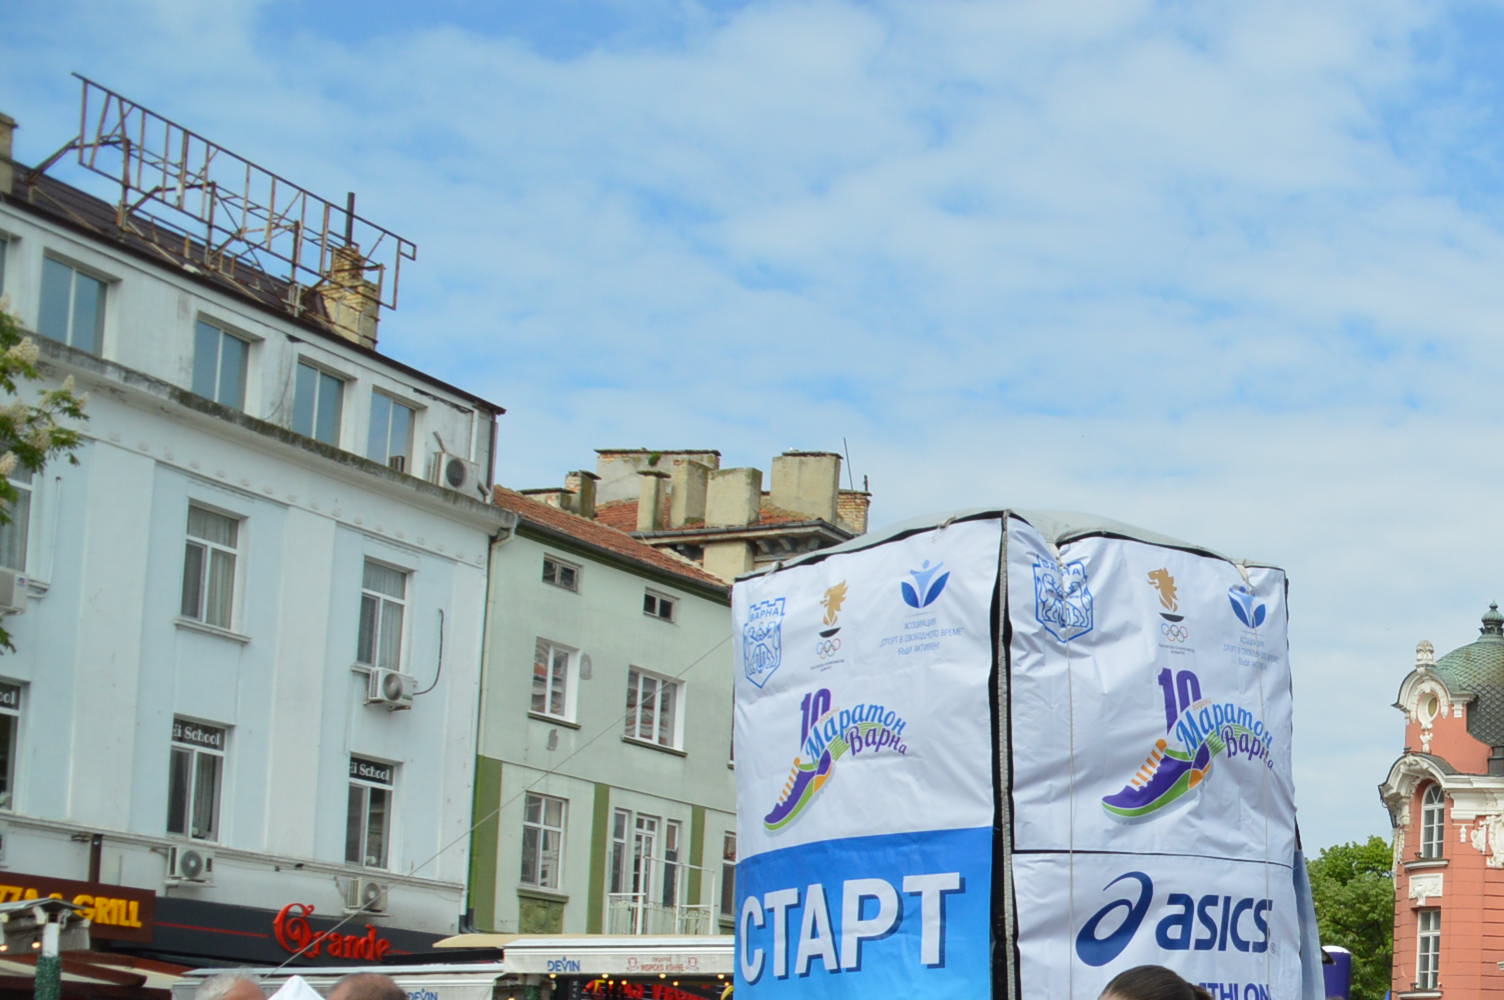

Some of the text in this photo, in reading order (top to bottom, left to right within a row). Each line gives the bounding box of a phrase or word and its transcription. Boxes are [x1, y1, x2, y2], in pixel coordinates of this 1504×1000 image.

[805, 703, 907, 761] Маратон
[846, 725, 908, 757] Варна
[1176, 703, 1273, 760] Маратон
[72, 893, 143, 929] GRILL
[273, 902, 392, 961] Grande
[740, 872, 965, 985] СТАРТ
[1155, 893, 1274, 953] asics
[547, 955, 580, 973] DEVIN
